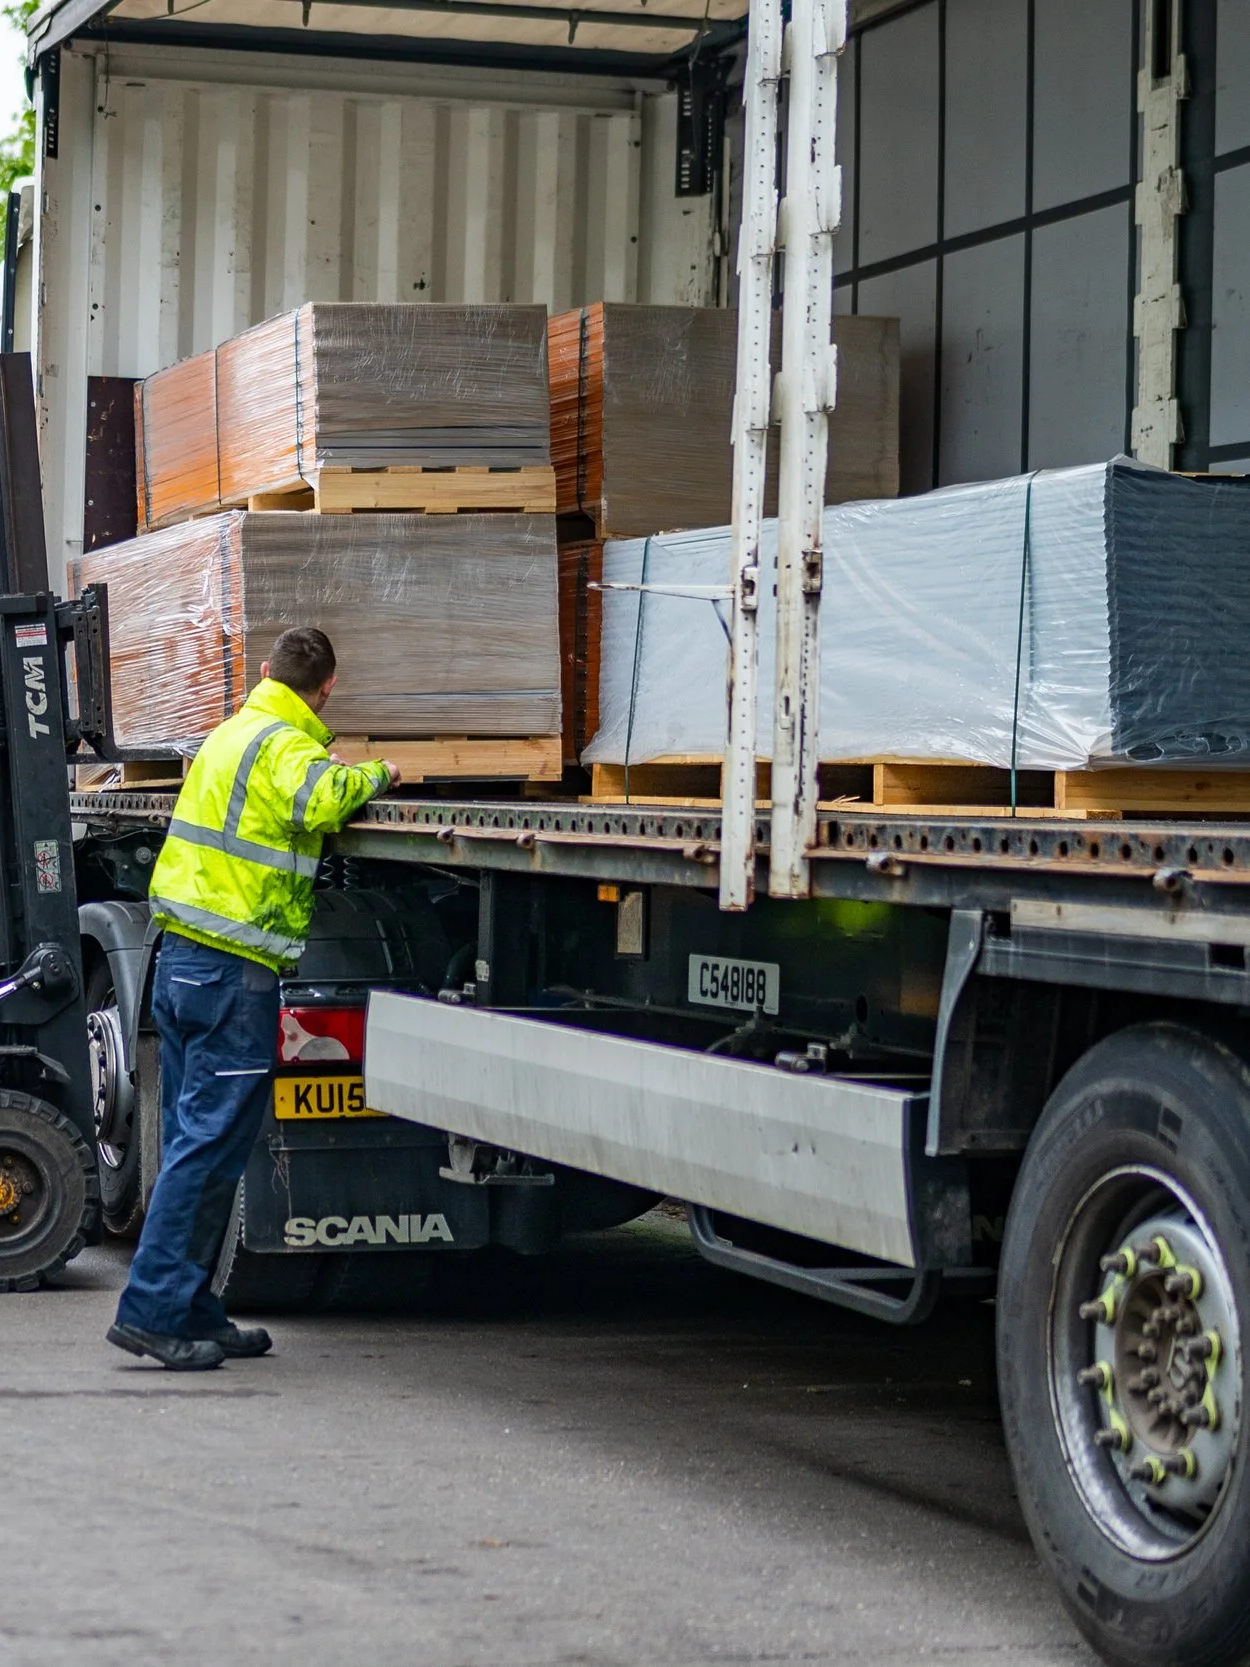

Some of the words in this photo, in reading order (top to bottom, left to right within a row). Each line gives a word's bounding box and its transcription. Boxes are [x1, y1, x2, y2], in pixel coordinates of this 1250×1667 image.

[22, 656, 50, 739] TCM
[699, 962, 766, 1006] C548188
[283, 1213, 454, 1247] SCANIA
